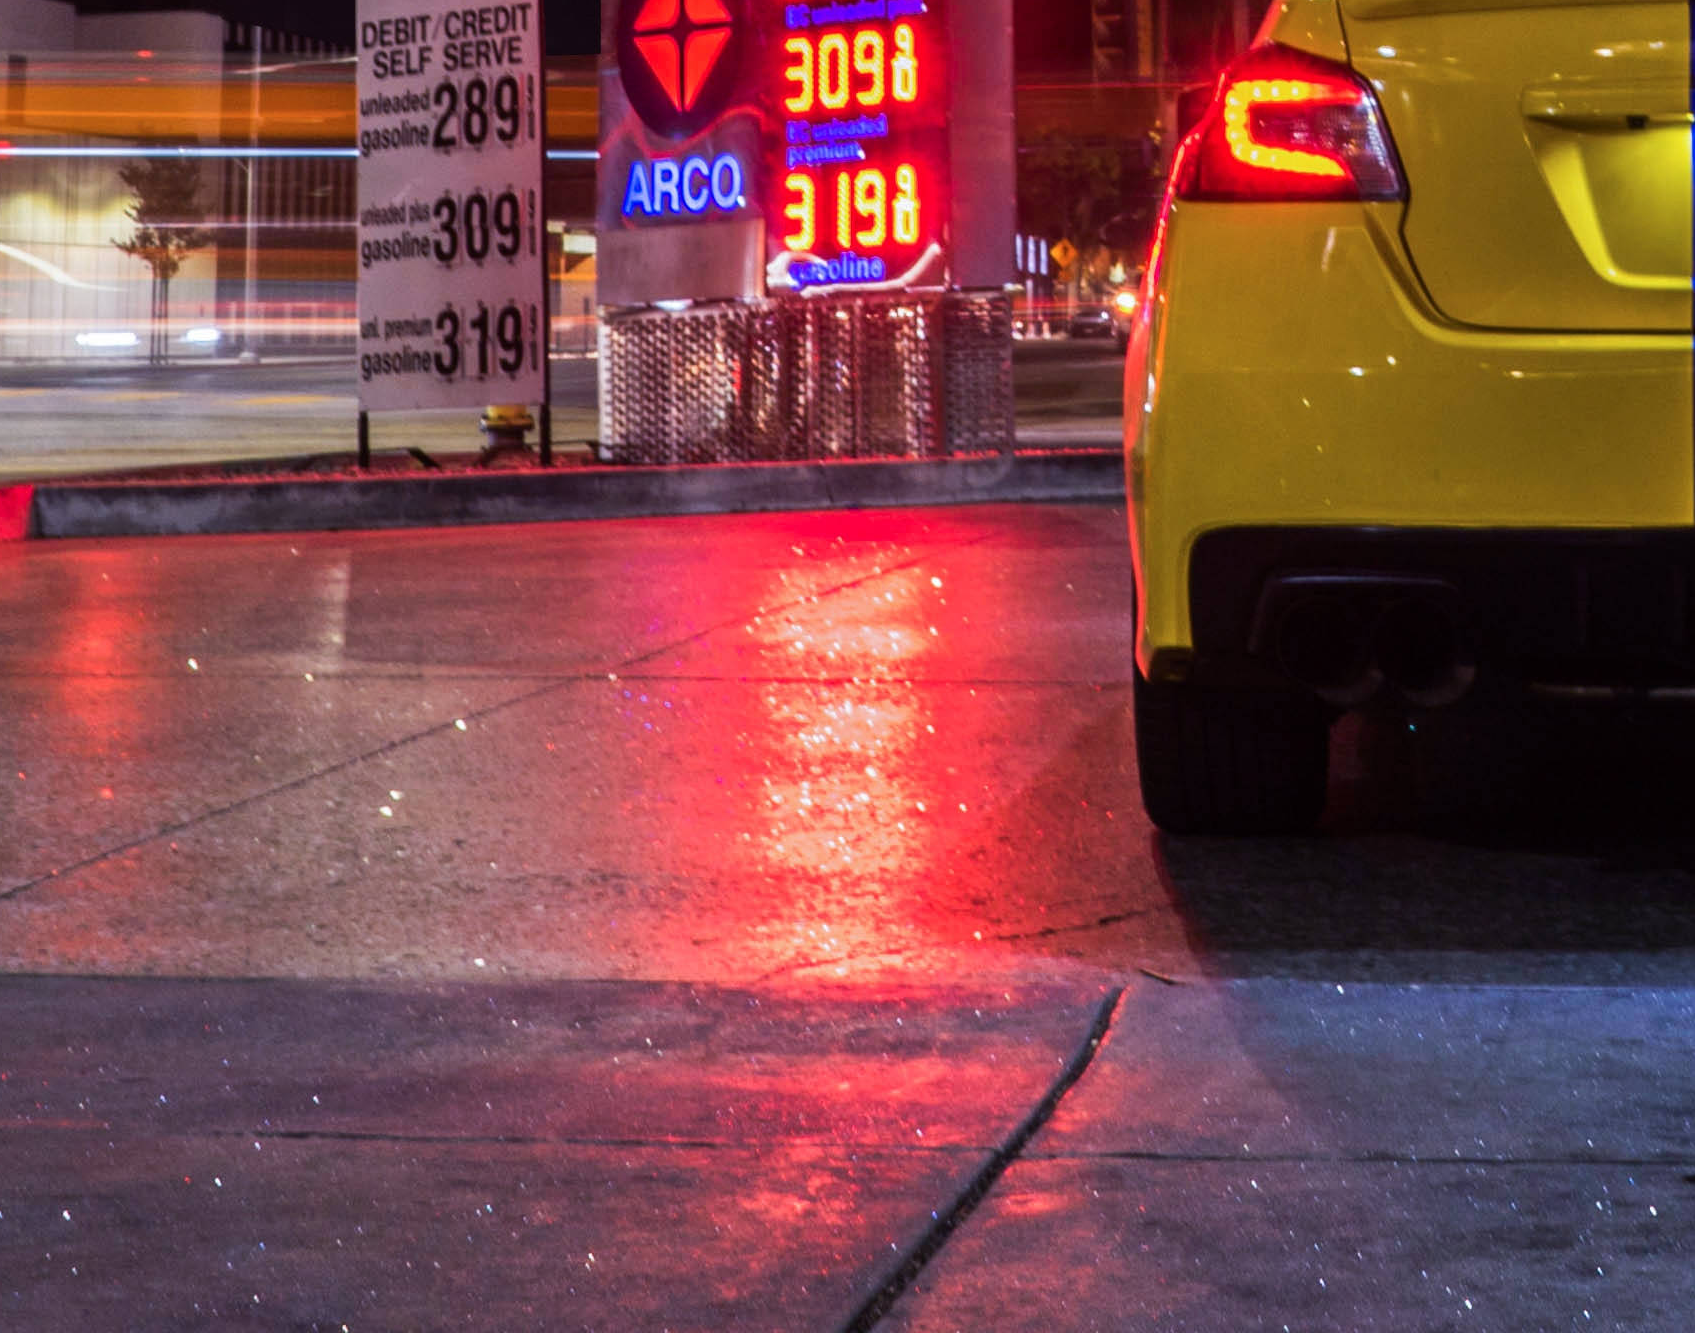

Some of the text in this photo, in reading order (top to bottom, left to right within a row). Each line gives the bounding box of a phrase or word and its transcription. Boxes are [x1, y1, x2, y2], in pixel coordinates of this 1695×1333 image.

[373, 35, 523, 79] SELF SERVE
[360, 86, 431, 117] unleaded
[361, 119, 430, 158] gasoline
[786, 141, 861, 170] premium
[622, 153, 742, 216] ARCO
[361, 230, 432, 269] gasoline
[361, 345, 433, 382] gasoline
